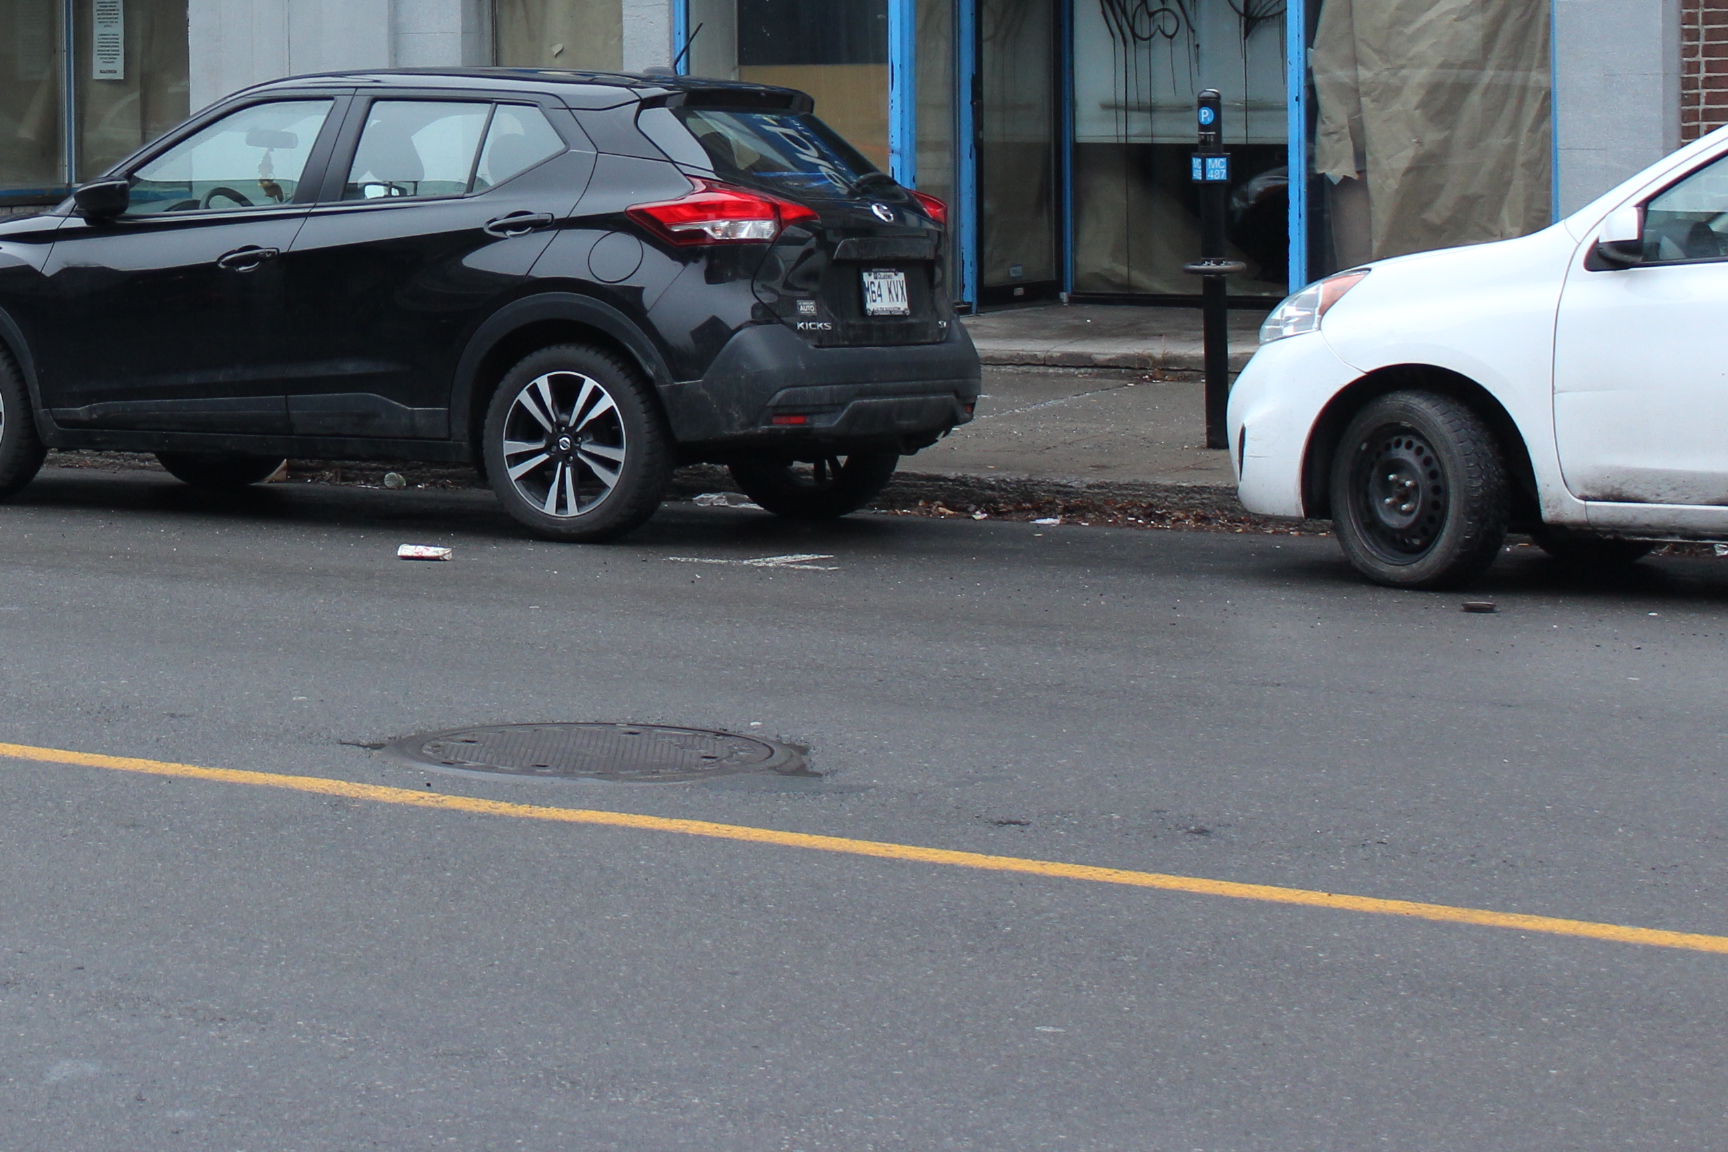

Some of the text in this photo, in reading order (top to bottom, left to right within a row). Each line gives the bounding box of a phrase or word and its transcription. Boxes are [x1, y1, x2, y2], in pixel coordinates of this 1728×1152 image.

[1208, 158, 1226, 169] MC
[1207, 169, 1227, 180] 487
[887, 280, 907, 302] KVX
[796, 321, 832, 331] KICKS
